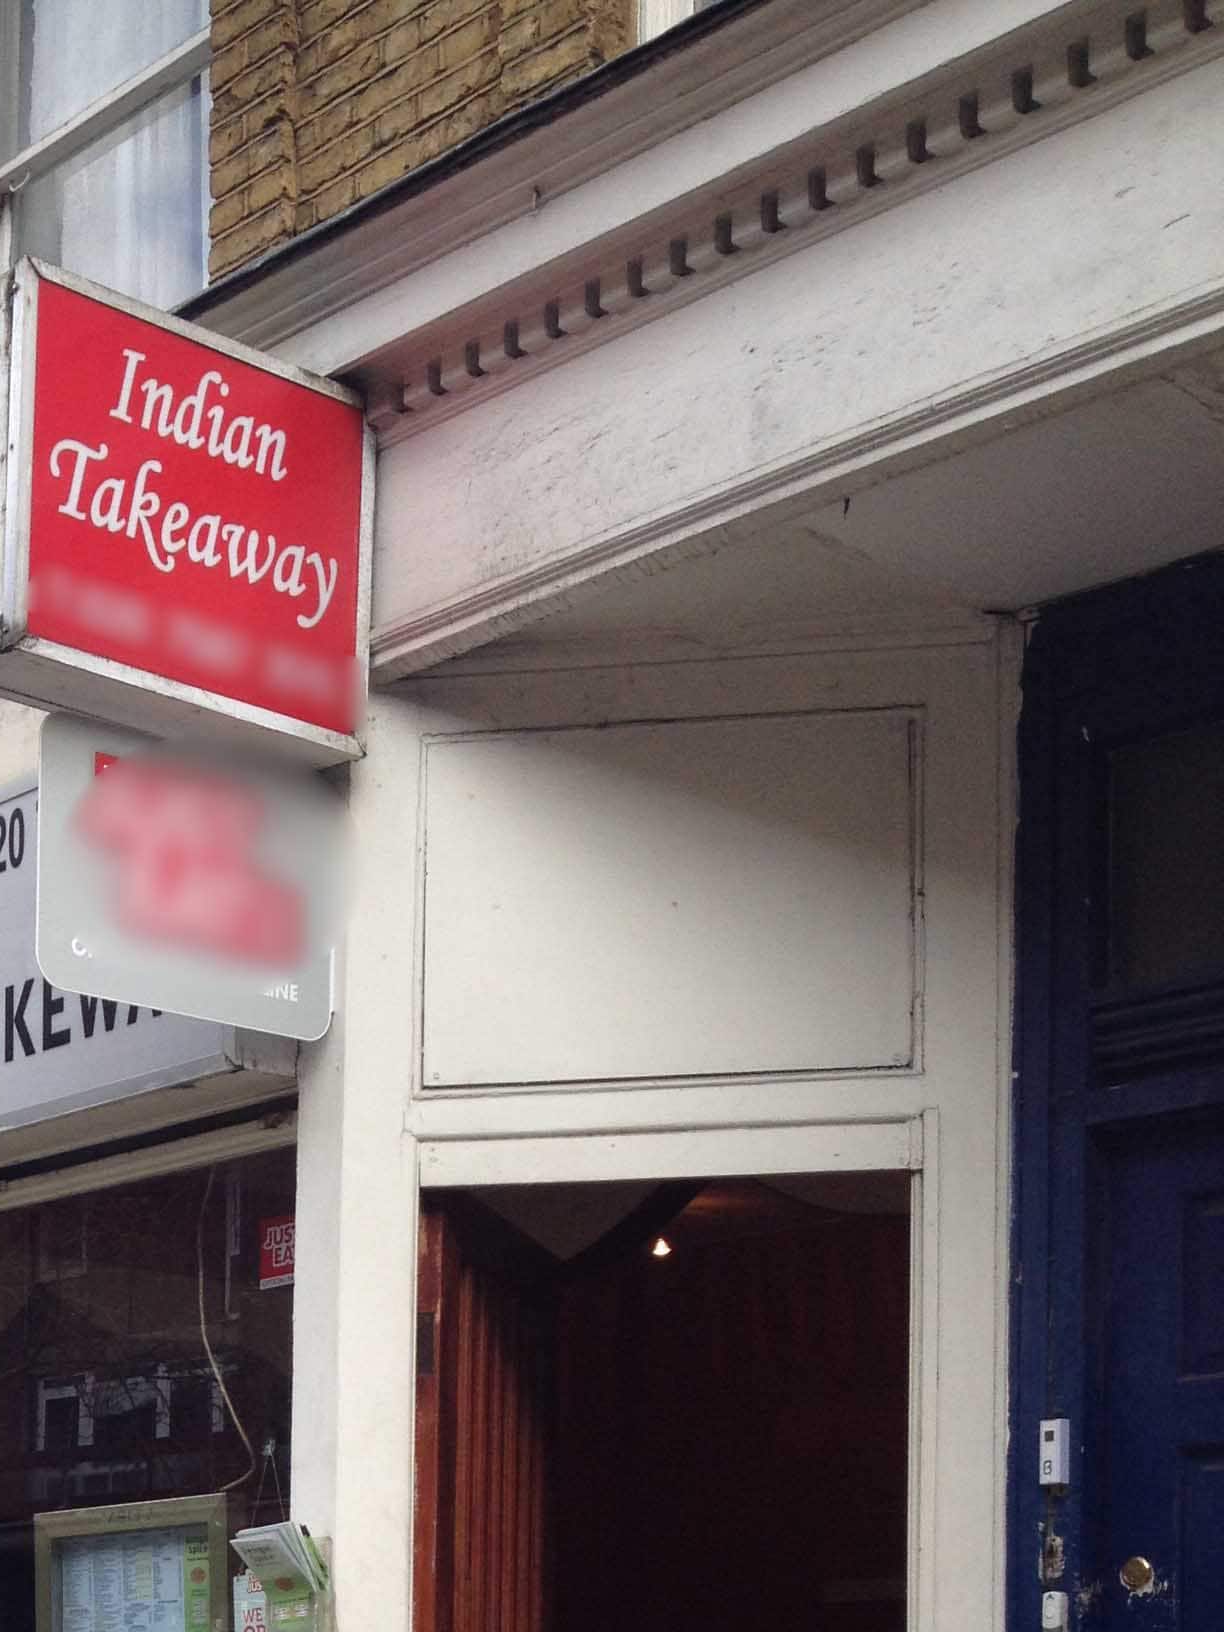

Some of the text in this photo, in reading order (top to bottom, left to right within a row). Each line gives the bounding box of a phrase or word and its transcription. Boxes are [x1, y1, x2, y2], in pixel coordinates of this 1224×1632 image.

[109, 348, 287, 481] Indian
[49, 438, 338, 629] Takeaway
[263, 1222, 295, 1250] JUS
[273, 1246, 295, 1267] EA
